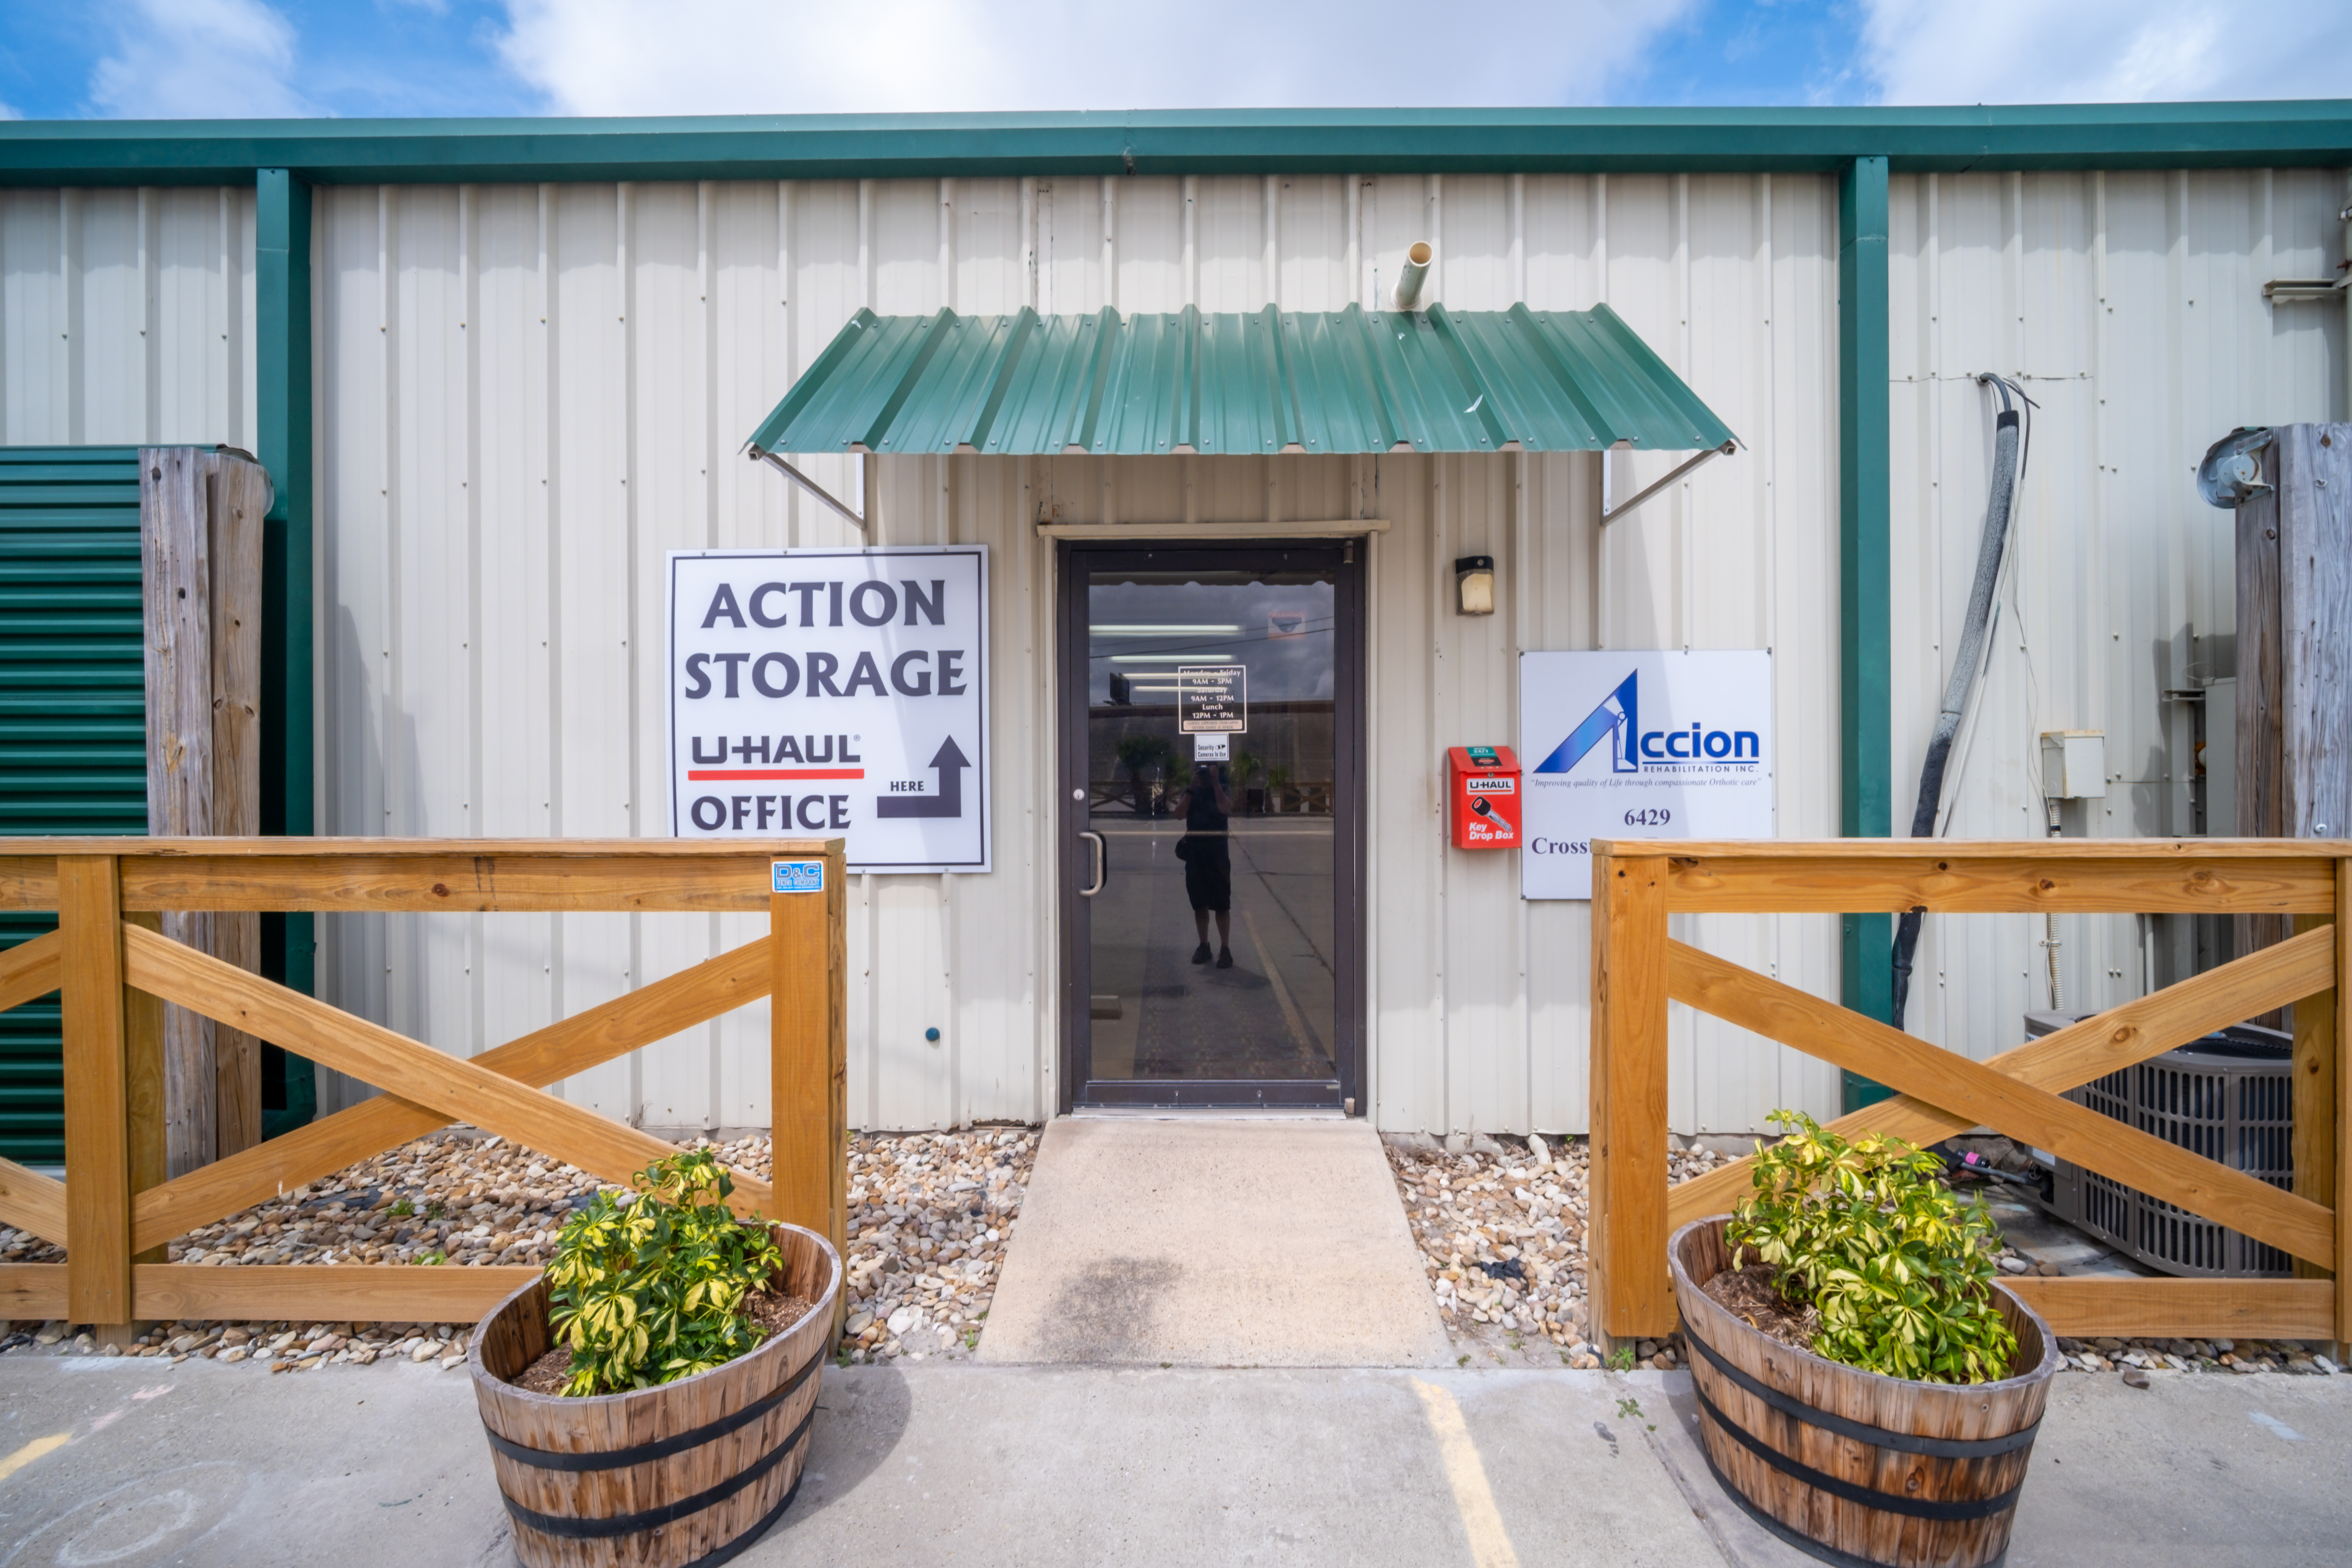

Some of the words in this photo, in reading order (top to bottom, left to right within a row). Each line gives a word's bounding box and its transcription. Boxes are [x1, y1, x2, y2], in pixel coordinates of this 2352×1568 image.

[700, 579, 946, 629] ACTION
[685, 650, 968, 699] STORAGE
[890, 780, 924, 792] HERE
[1573, 779, 1598, 788] quality
[1600, 778, 1609, 788] of
[1609, 778, 1623, 788] Life
[1625, 778, 1652, 788] through
[1655, 778, 1707, 788] compassionate
[691, 795, 852, 831] OFFICE
[1624, 809, 1670, 825] 6429
[1469, 822, 1487, 832] Key
[1469, 832, 1493, 841] Drop
[1495, 831, 1514, 839] Box
[1532, 837, 1591, 854] Cross
[776, 864, 820, 879] D&C
